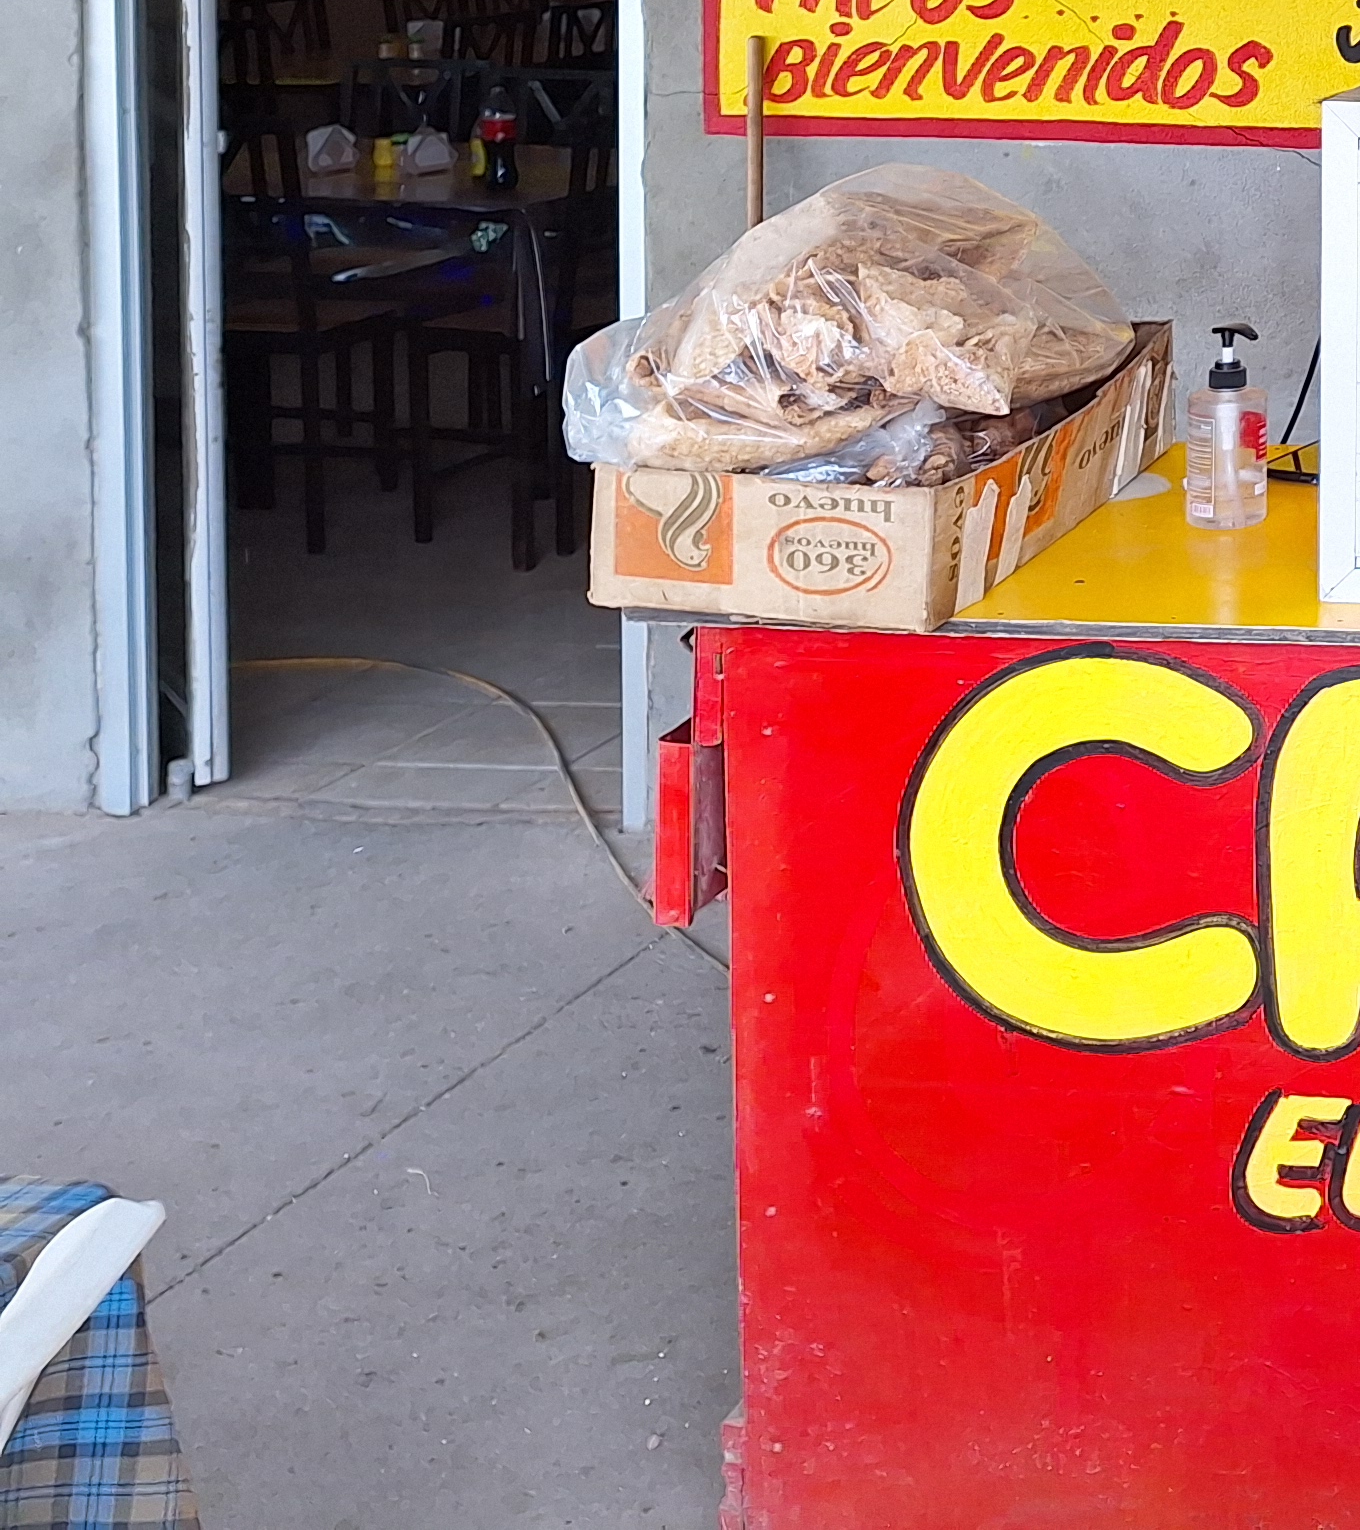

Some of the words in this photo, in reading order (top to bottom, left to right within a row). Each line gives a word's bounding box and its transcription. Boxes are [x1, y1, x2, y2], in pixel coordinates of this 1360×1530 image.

[744, 20, 1274, 110] Bienvenidos
[767, 492, 896, 524] huevo
[784, 536, 878, 559] huevos
[785, 548, 870, 577] 360
